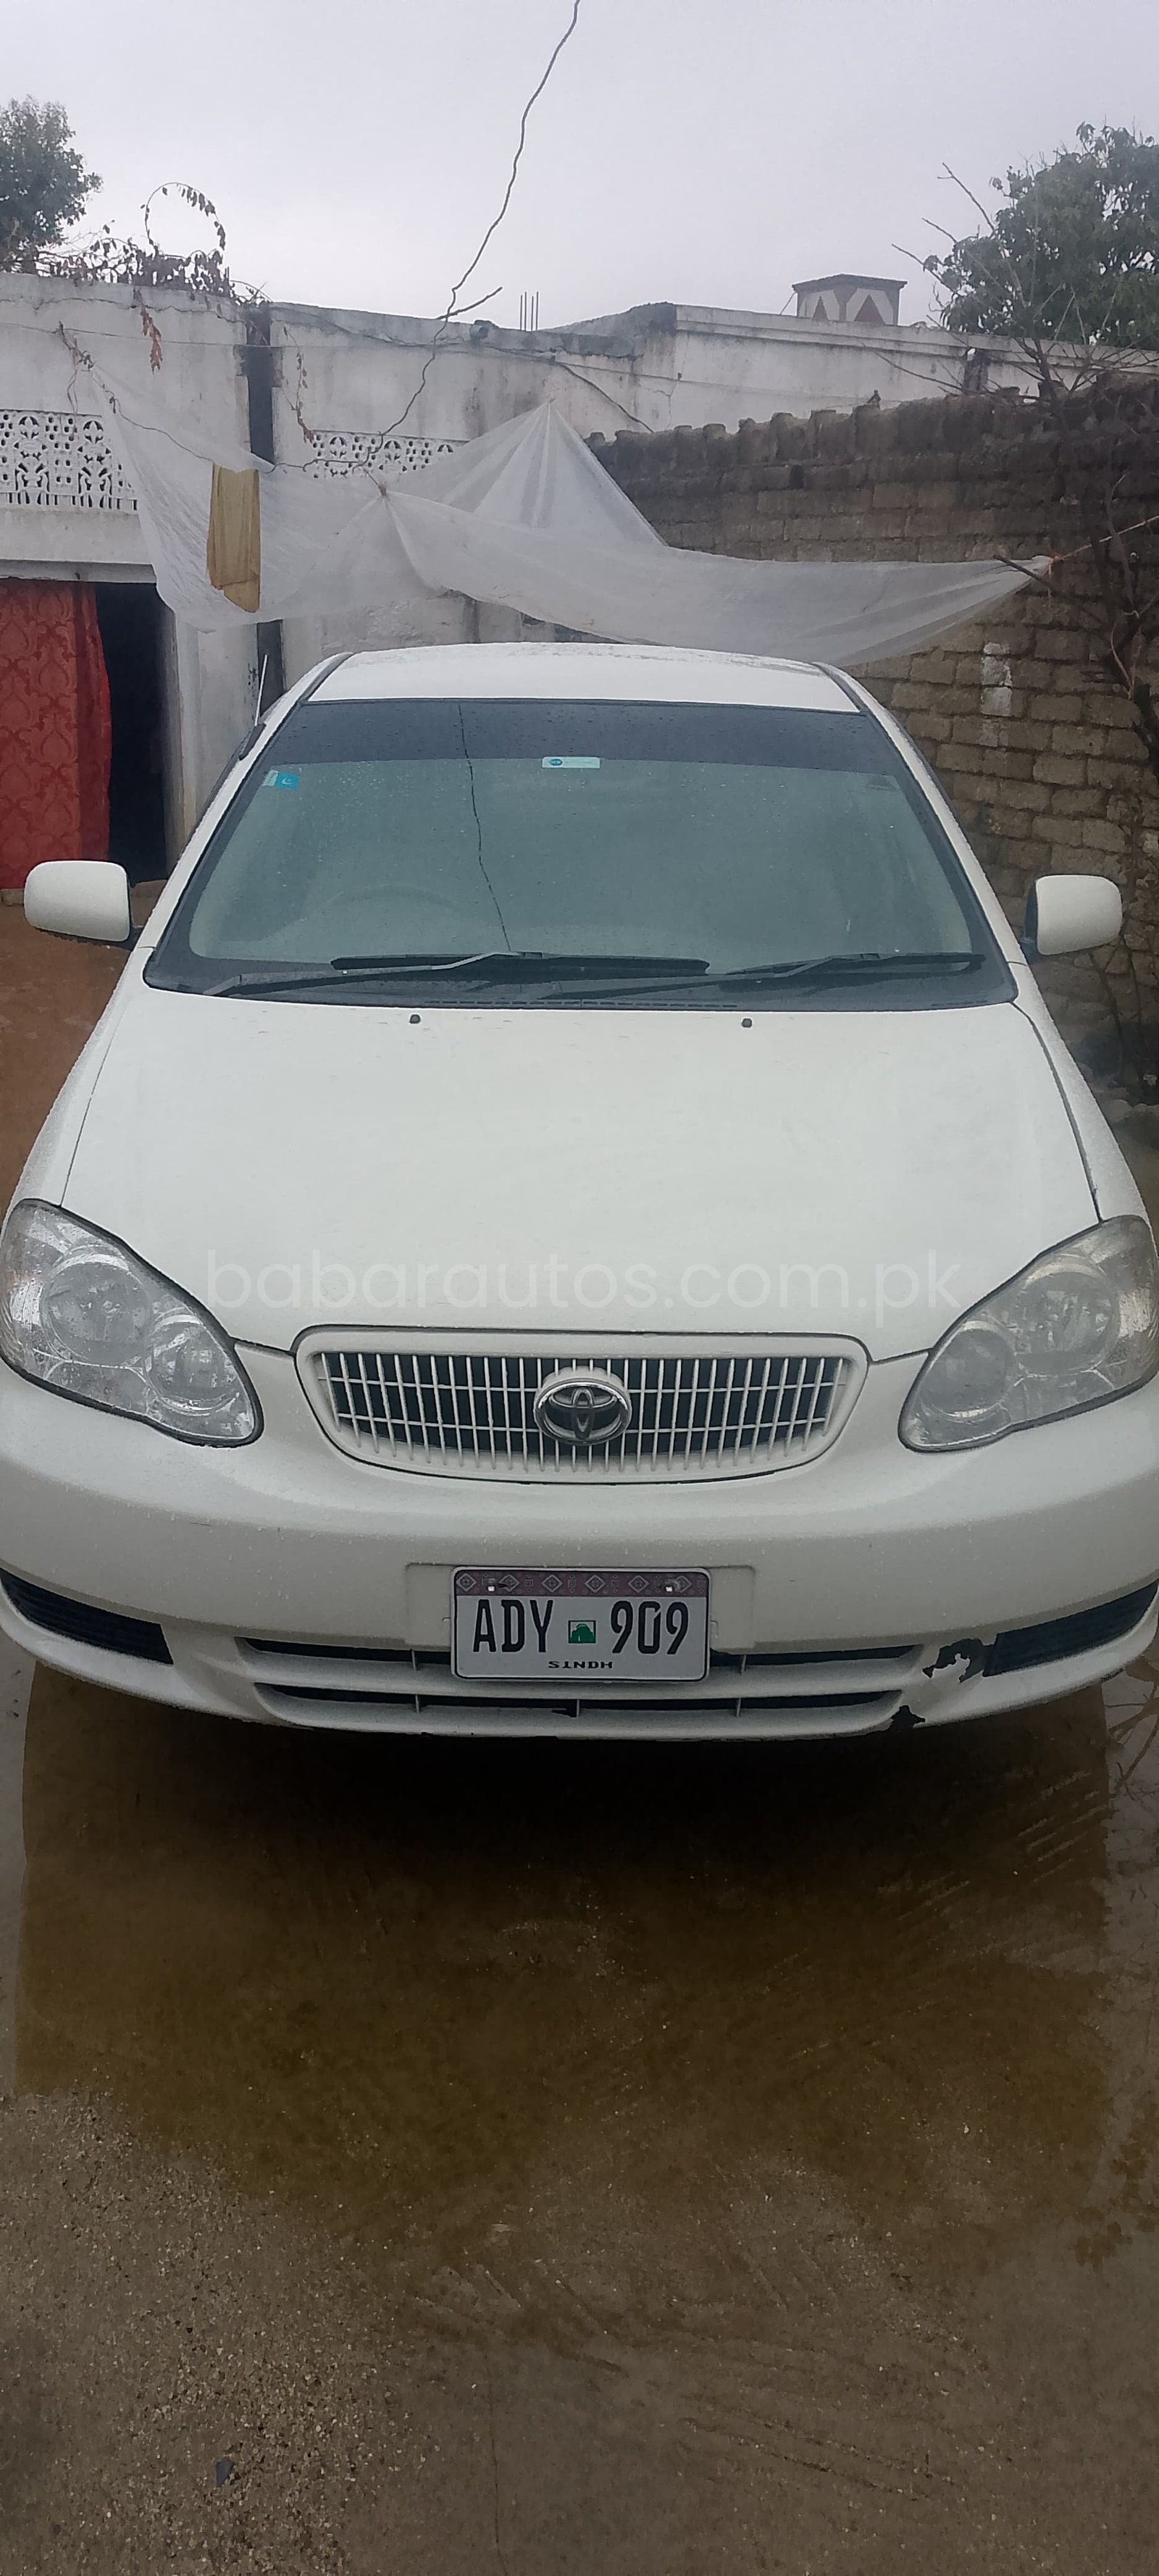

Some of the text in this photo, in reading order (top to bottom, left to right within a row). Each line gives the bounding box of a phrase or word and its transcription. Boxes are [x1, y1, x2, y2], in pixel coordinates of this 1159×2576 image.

[472, 1599, 689, 1655] ADY 909
[548, 1660, 613, 1669] SINDH
